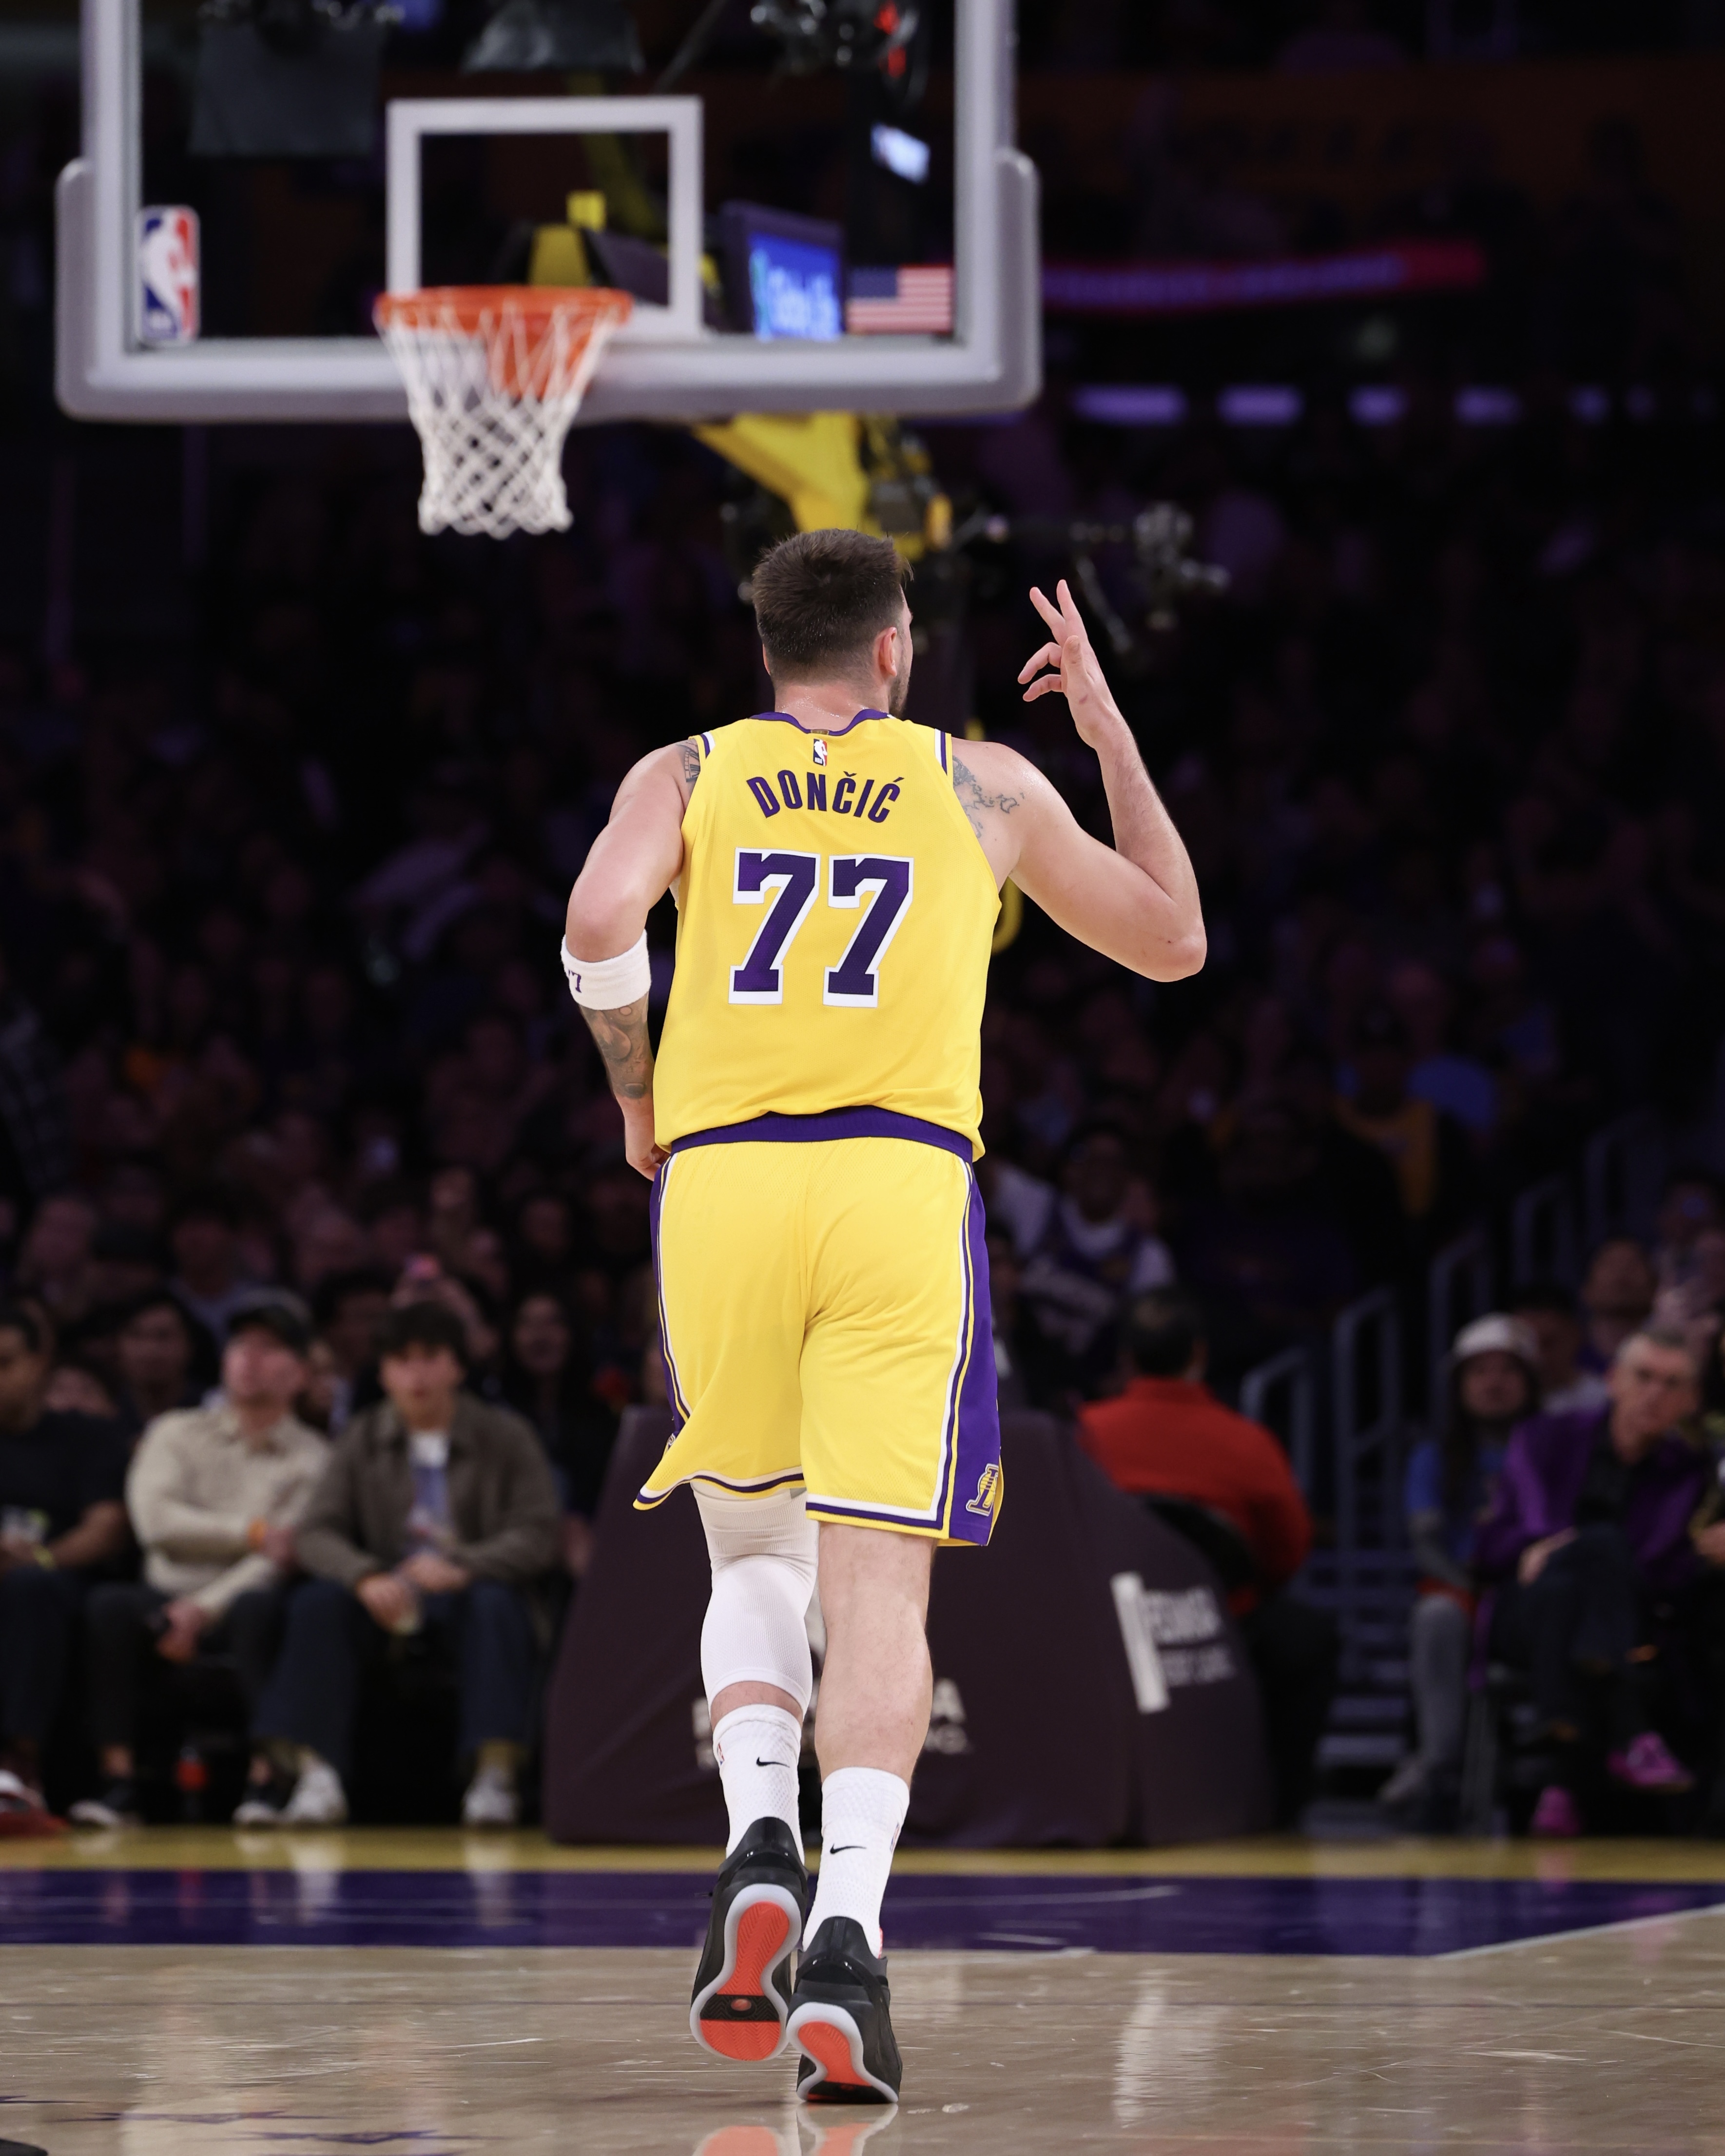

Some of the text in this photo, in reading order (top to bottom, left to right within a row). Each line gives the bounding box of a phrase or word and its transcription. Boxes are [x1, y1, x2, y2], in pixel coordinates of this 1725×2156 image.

[747, 770, 904, 823] DONČIĆ
[728, 847, 913, 1008] 77
[568, 969, 581, 993] 7
